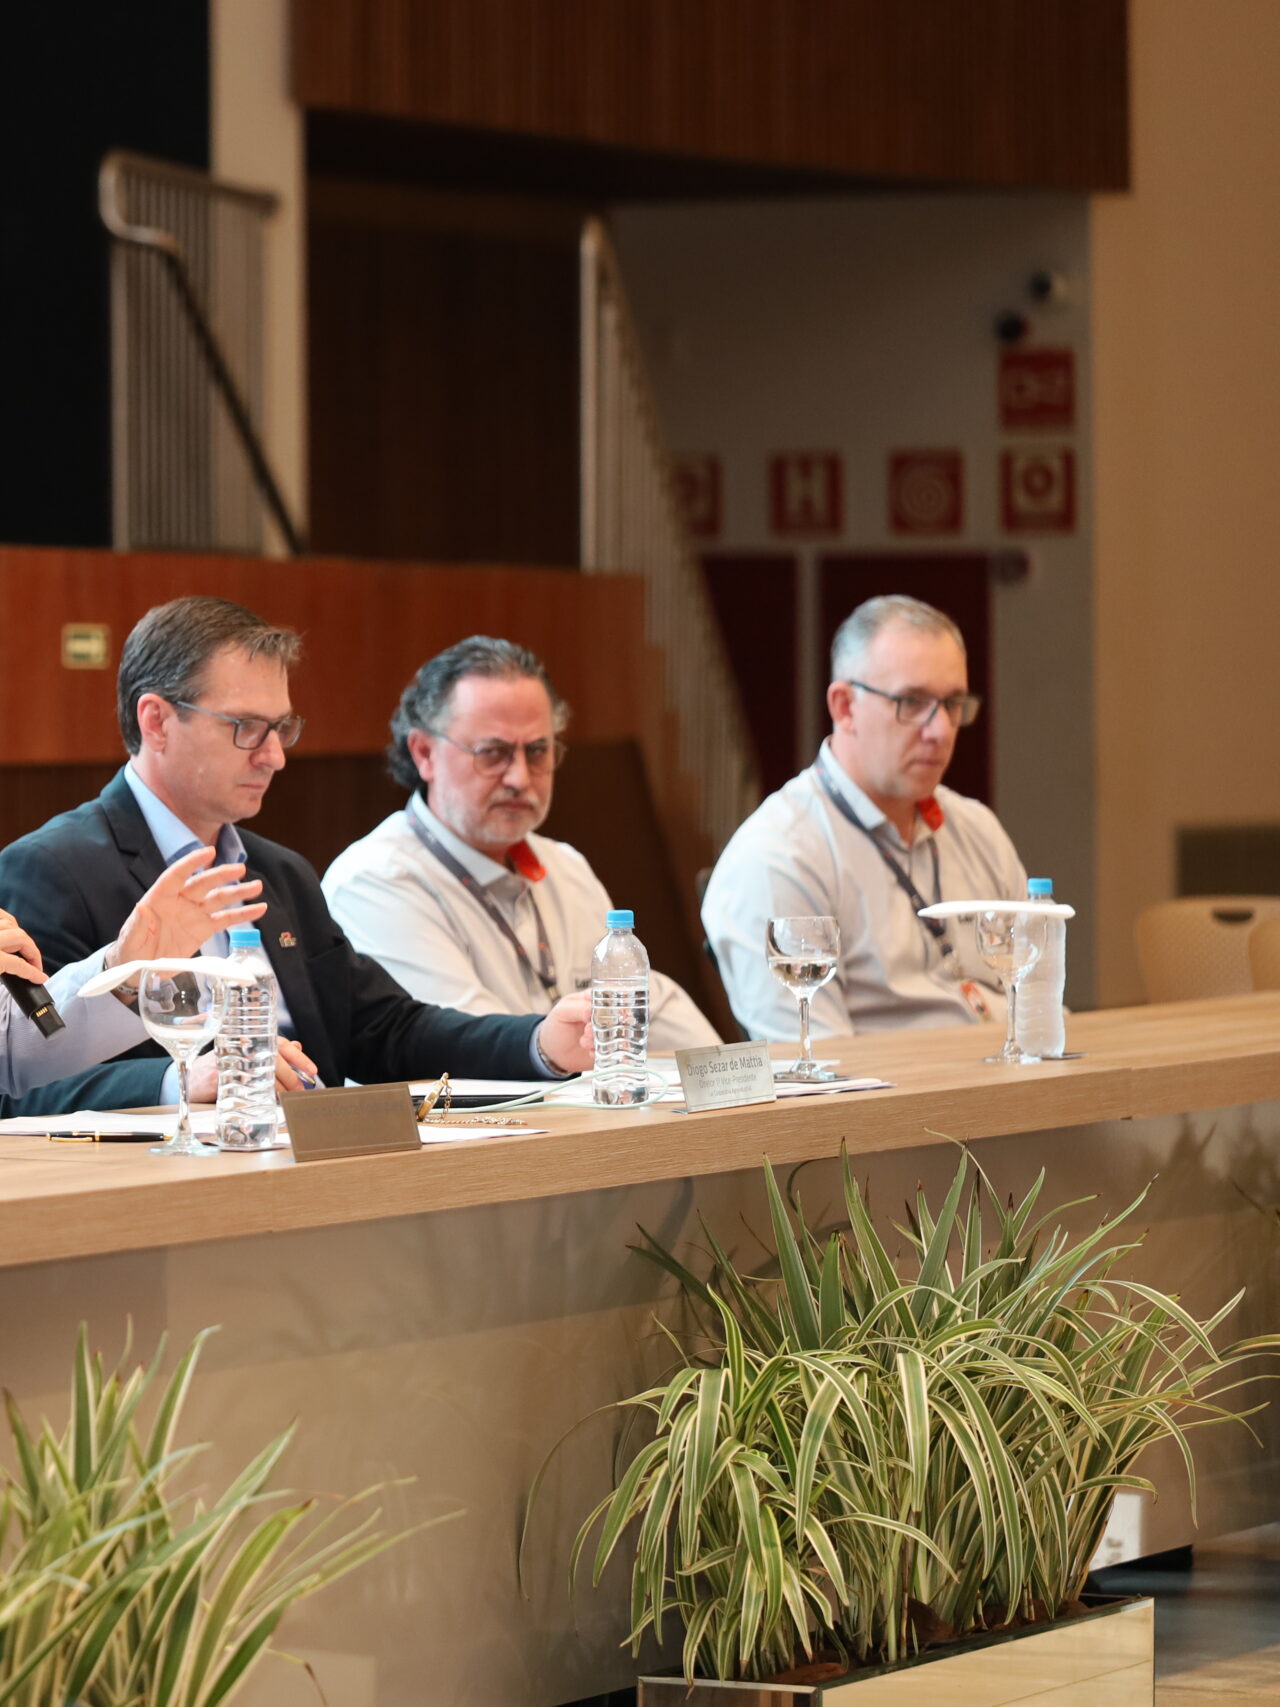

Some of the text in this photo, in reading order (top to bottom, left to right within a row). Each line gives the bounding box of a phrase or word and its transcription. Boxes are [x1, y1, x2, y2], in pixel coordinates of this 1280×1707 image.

[687, 1063, 708, 1078] Diogo
[709, 1061, 729, 1073] Sezar
[730, 1058, 739, 1070] de
